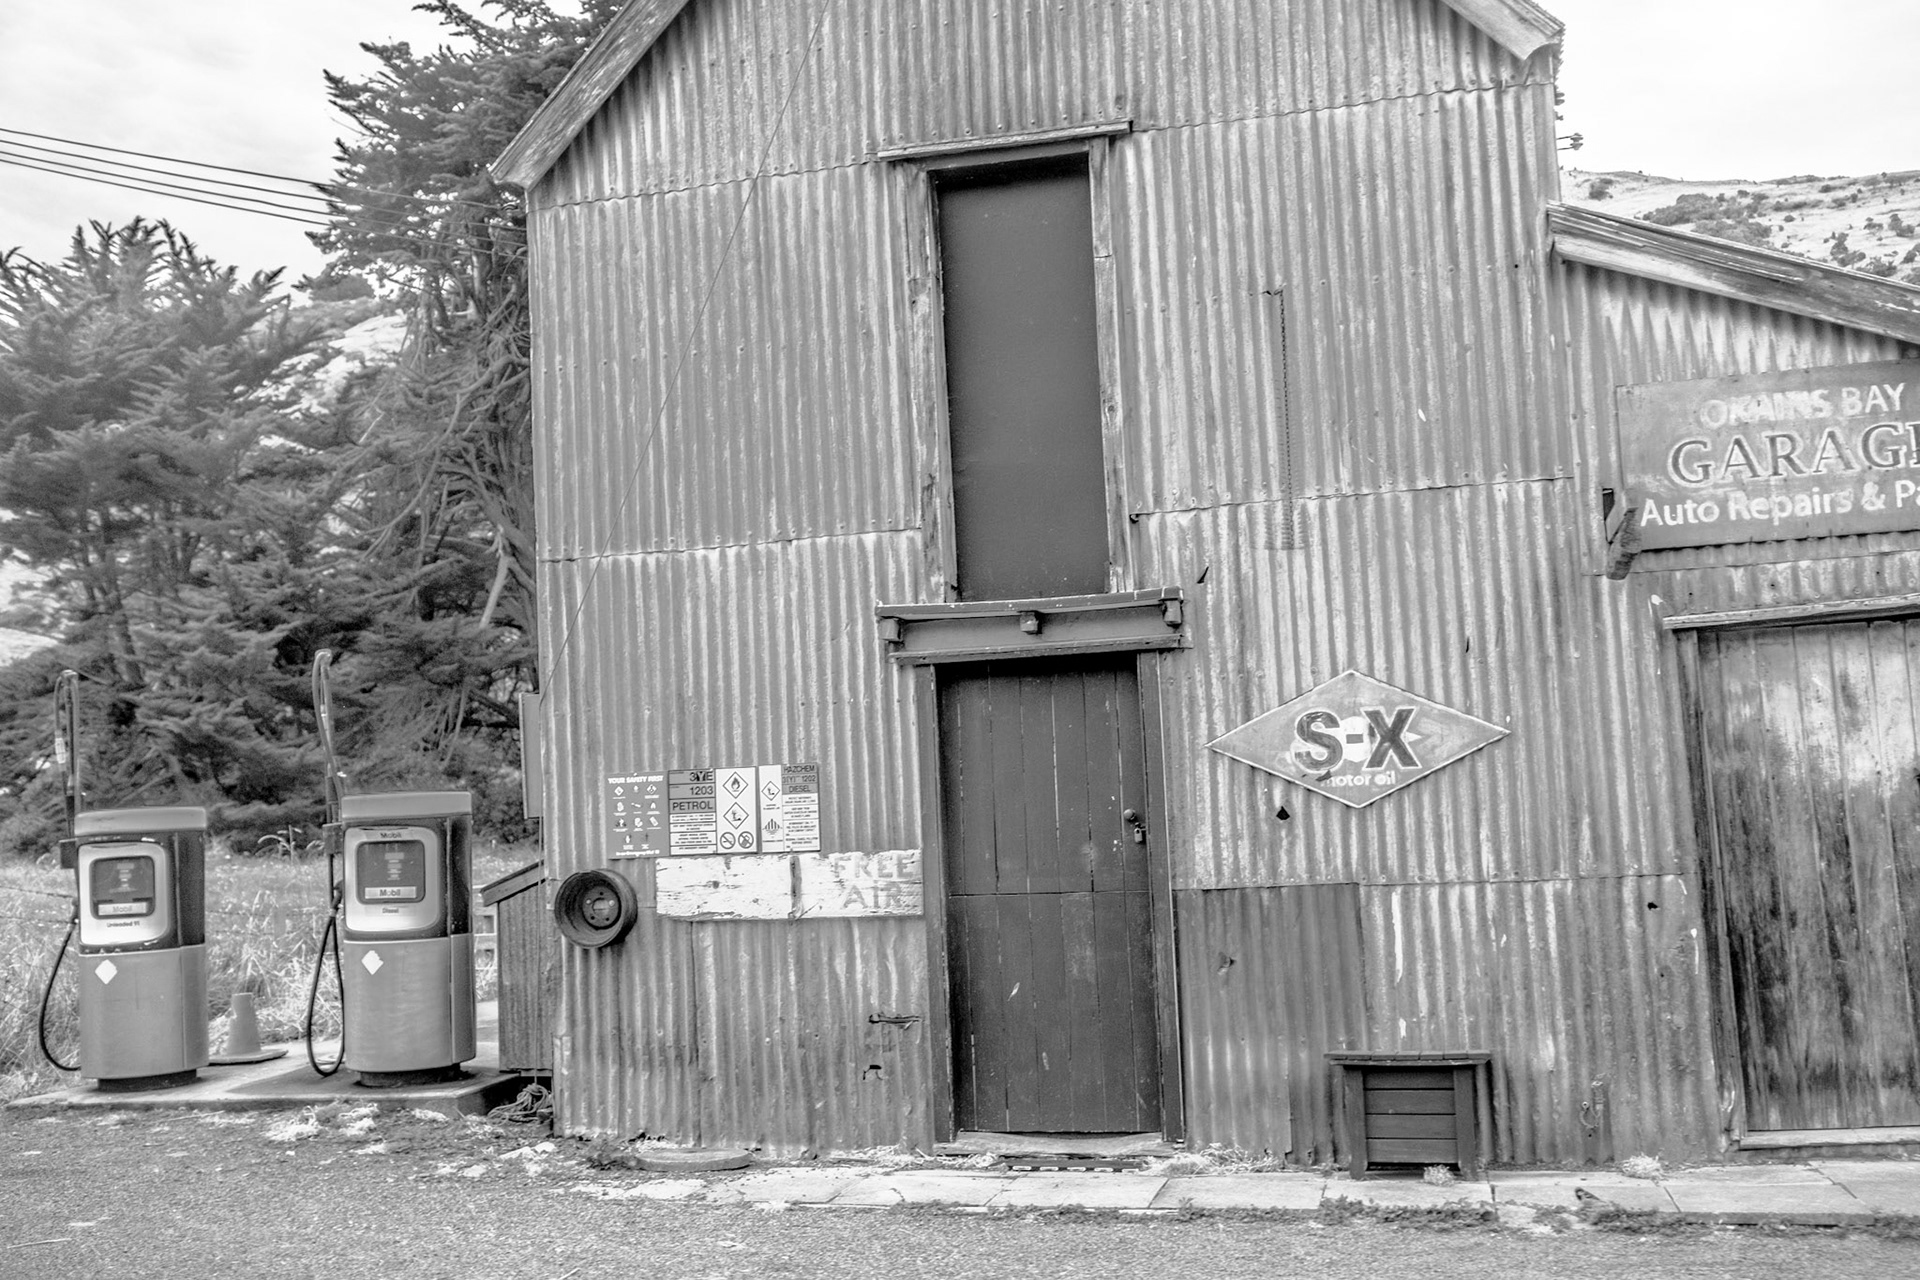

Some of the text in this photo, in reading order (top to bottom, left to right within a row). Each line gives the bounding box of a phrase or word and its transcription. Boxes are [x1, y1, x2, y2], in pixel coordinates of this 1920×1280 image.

[1842, 383, 1905, 416] BAY
[1640, 498, 1720, 527] Auto
[1727, 487, 1854, 526] Repairs
[1861, 481, 1886, 511] &
[783, 765, 815, 773] HAZCHEM
[1374, 770, 1395, 785] oil
[690, 785, 713, 795] 1203
[789, 785, 811, 793] DIESEL
[672, 801, 713, 811] PETROL
[834, 854, 914, 878] FREE
[843, 880, 902, 909] AIR
